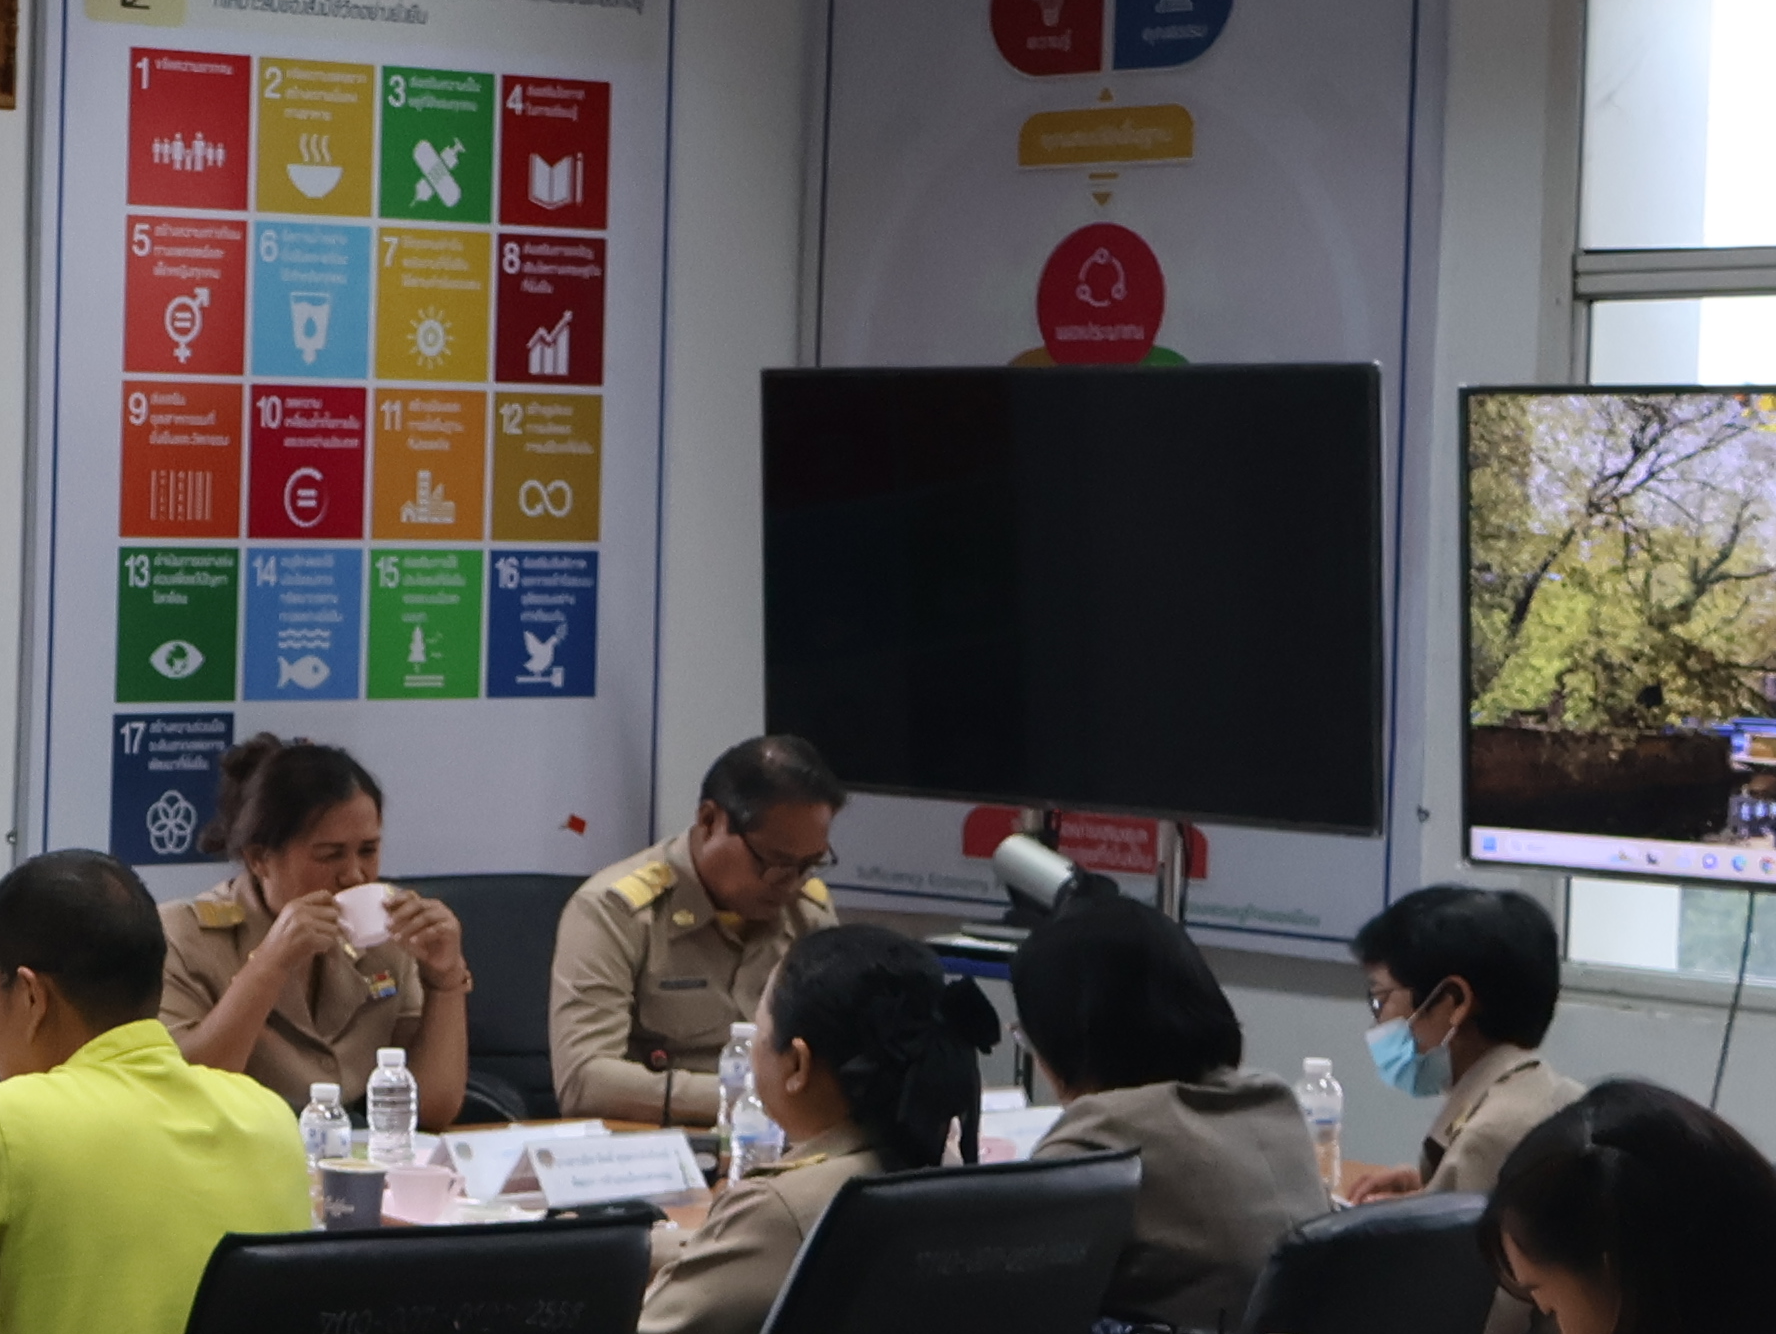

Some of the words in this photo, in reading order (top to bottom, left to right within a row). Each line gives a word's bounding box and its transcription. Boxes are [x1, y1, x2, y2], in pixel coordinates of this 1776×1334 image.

[136, 57, 149, 89] 1
[264, 67, 282, 99] 2
[388, 75, 406, 107] 3
[507, 84, 523, 115] 4
[132, 224, 151, 257] 5
[260, 230, 278, 262] 6
[383, 237, 398, 267] 7
[503, 242, 521, 274] 8
[129, 392, 147, 426] 9
[257, 396, 282, 429] 10
[381, 400, 402, 430] 11
[500, 403, 524, 434] 12
[125, 555, 149, 587] 13
[253, 556, 276, 587] 14
[376, 557, 398, 588] 15
[120, 722, 144, 755] 17
